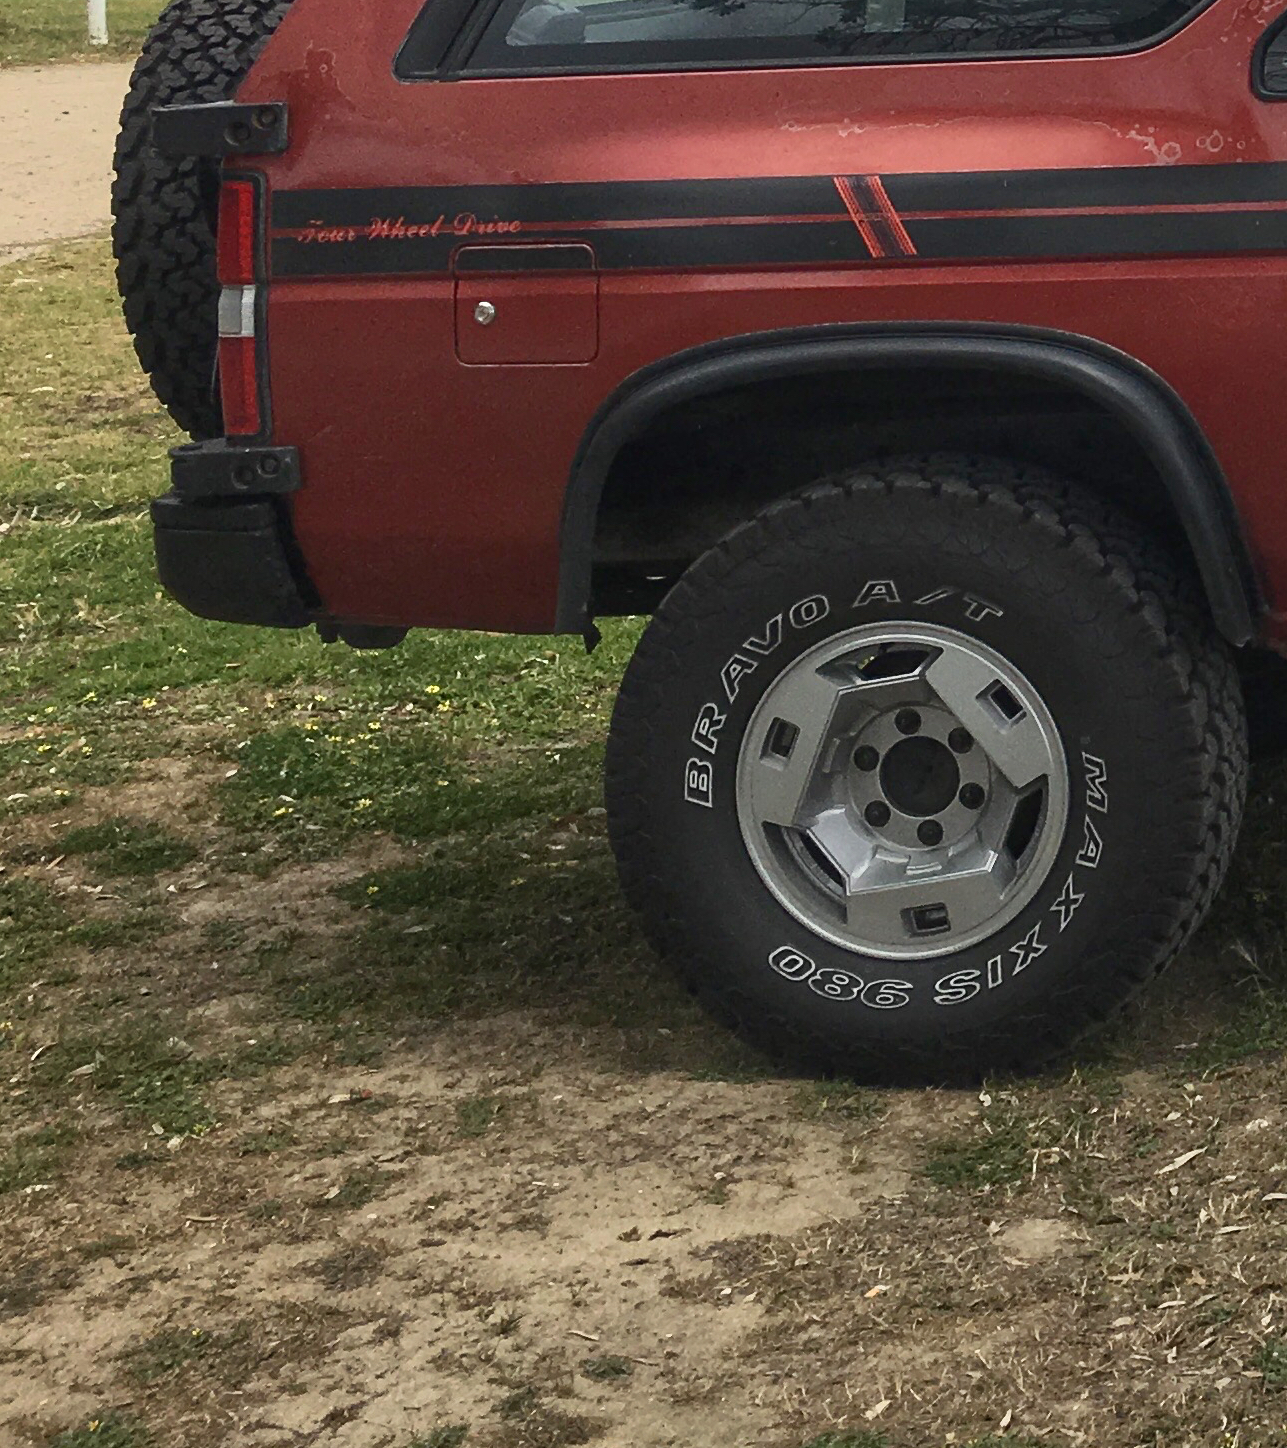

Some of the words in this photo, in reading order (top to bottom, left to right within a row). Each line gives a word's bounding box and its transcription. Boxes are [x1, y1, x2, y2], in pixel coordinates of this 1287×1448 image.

[365, 215, 445, 240] Wheel
[454, 212, 521, 235] Drive
[684, 594, 830, 807] BRAVO
[853, 580, 1003, 622] A/T
[933, 752, 1108, 1004] MAXXIS
[768, 945, 914, 1009] 980
